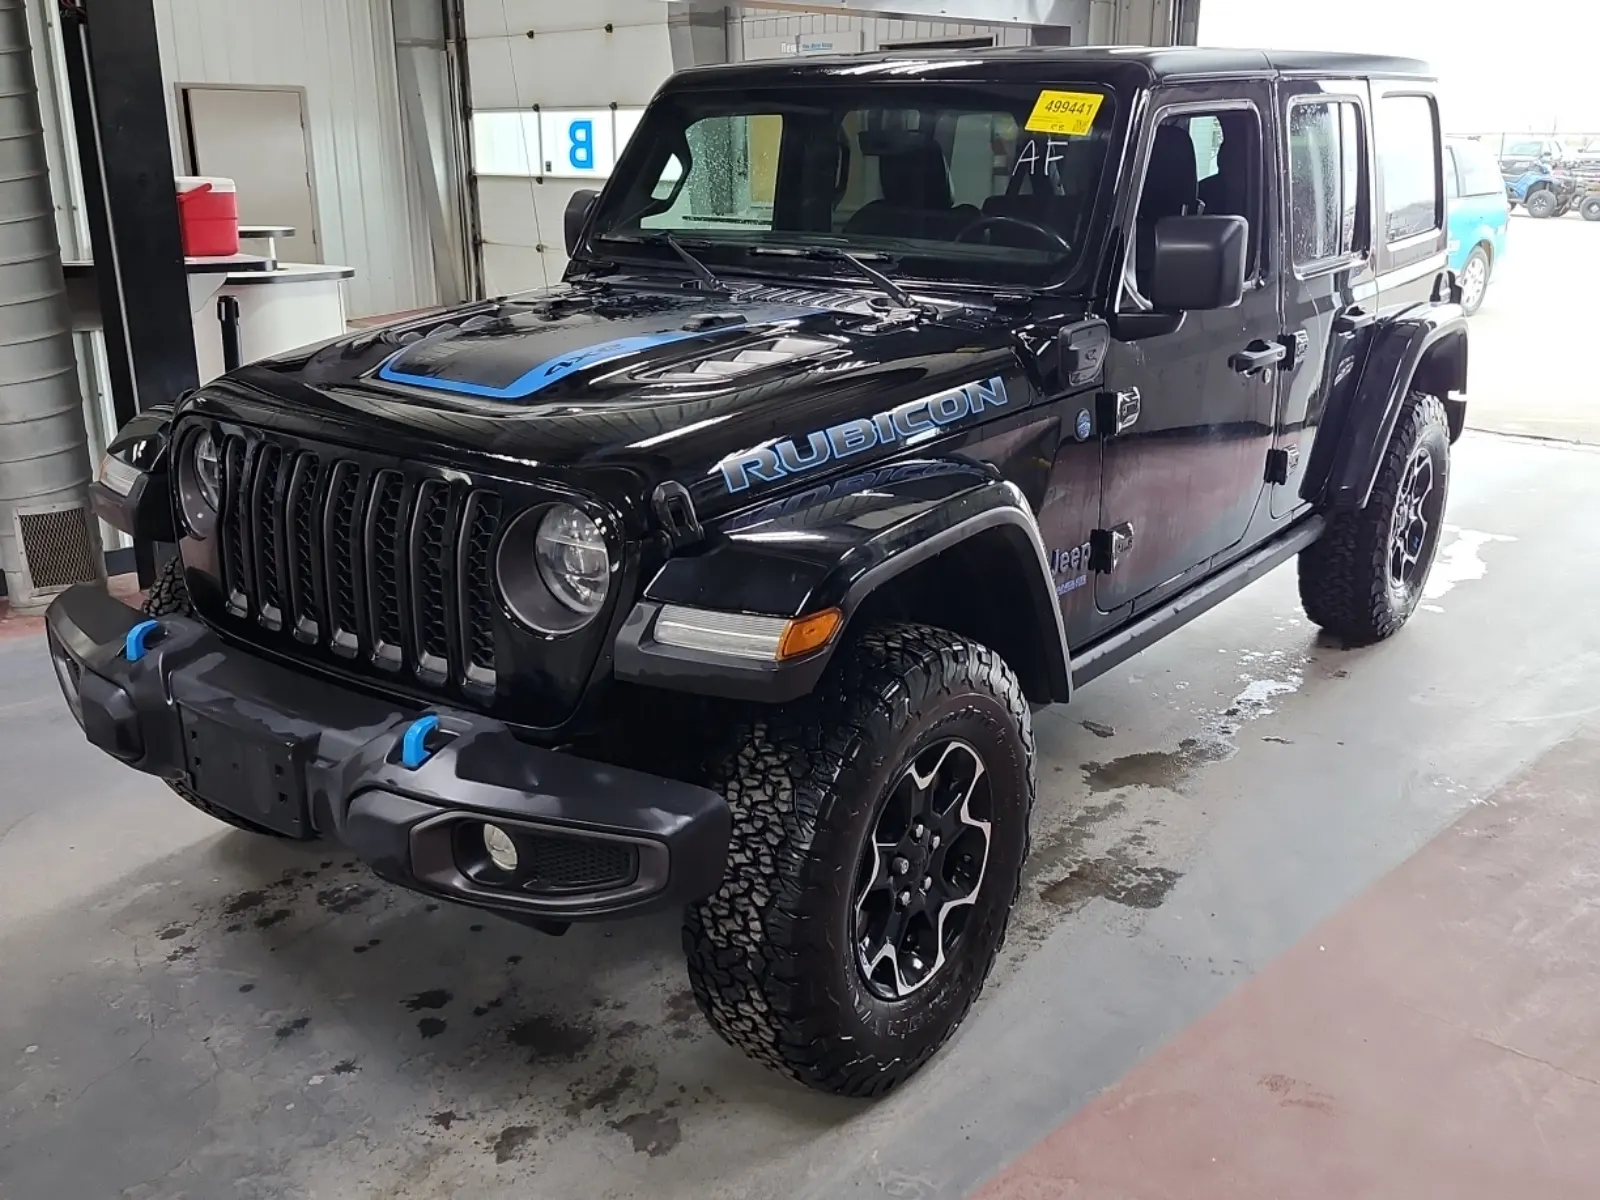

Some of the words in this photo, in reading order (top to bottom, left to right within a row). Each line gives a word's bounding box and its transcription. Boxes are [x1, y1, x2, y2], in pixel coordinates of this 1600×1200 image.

[1045, 100, 1094, 116] 499441
[1012, 139, 1068, 176] AF
[721, 376, 1008, 494] RUBICON
[1050, 541, 1091, 577] Jeep
